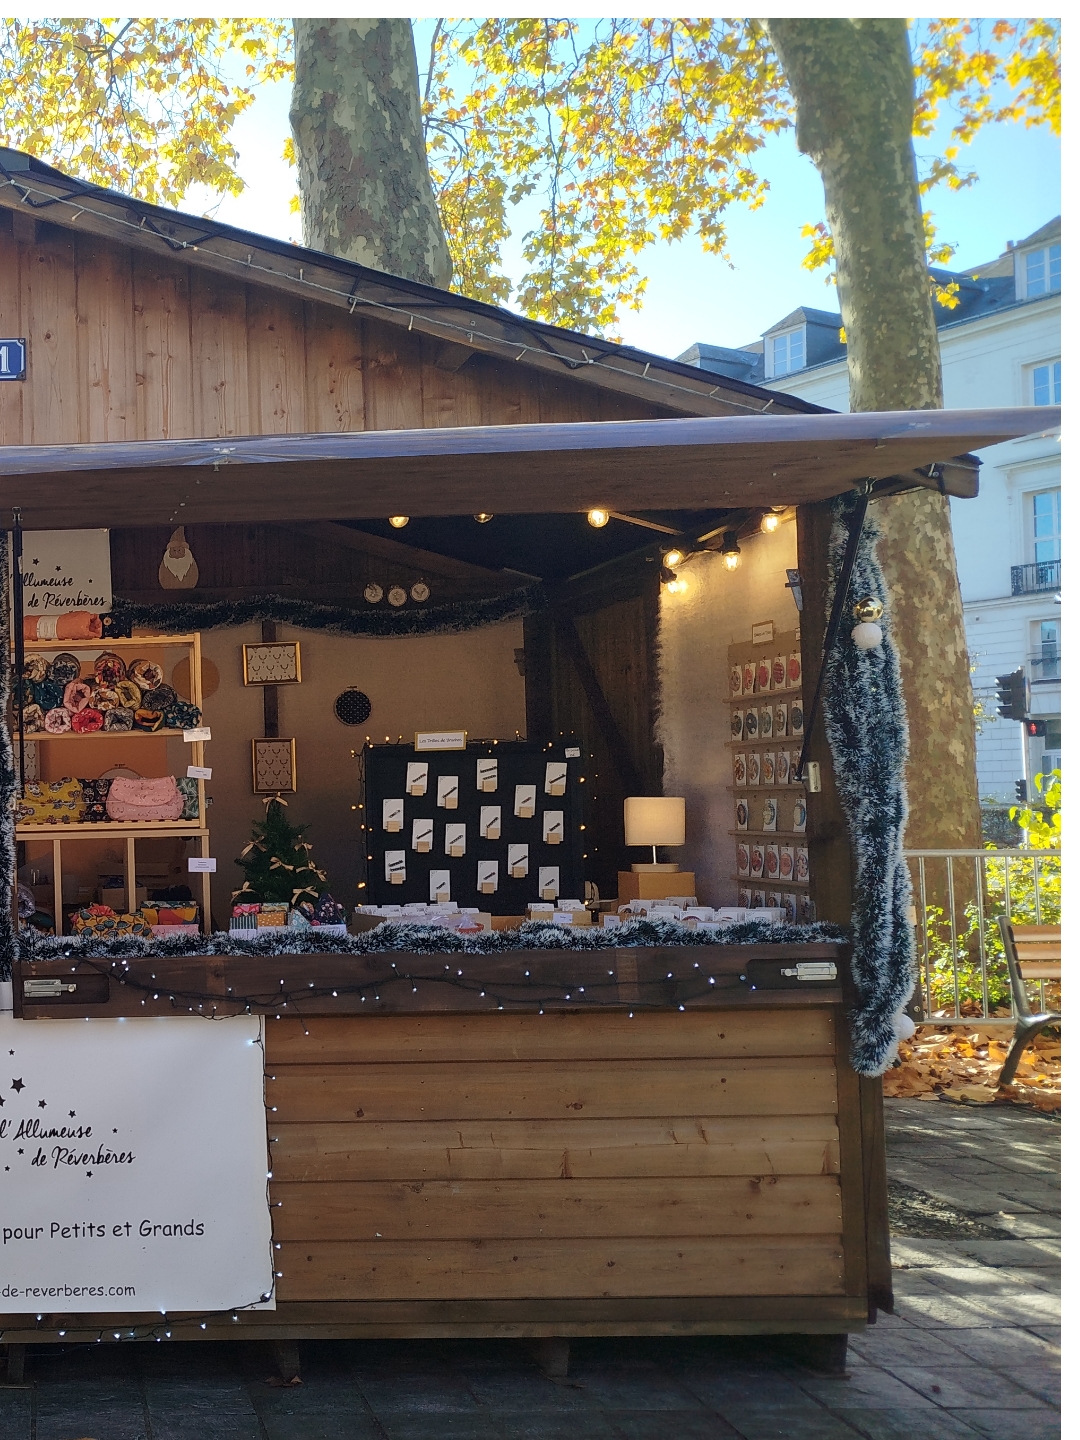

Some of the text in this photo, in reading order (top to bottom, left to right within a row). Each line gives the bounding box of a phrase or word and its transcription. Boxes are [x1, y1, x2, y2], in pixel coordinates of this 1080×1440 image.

[20, 573, 74, 587] llumeuse
[28, 593, 40, 607] de
[31, 1144, 135, 1169] de Réverbères
[3, 1227, 44, 1244] pour
[50, 1221, 106, 1239] Petits
[112, 1221, 132, 1237] et
[139, 1218, 205, 1237] Grands
